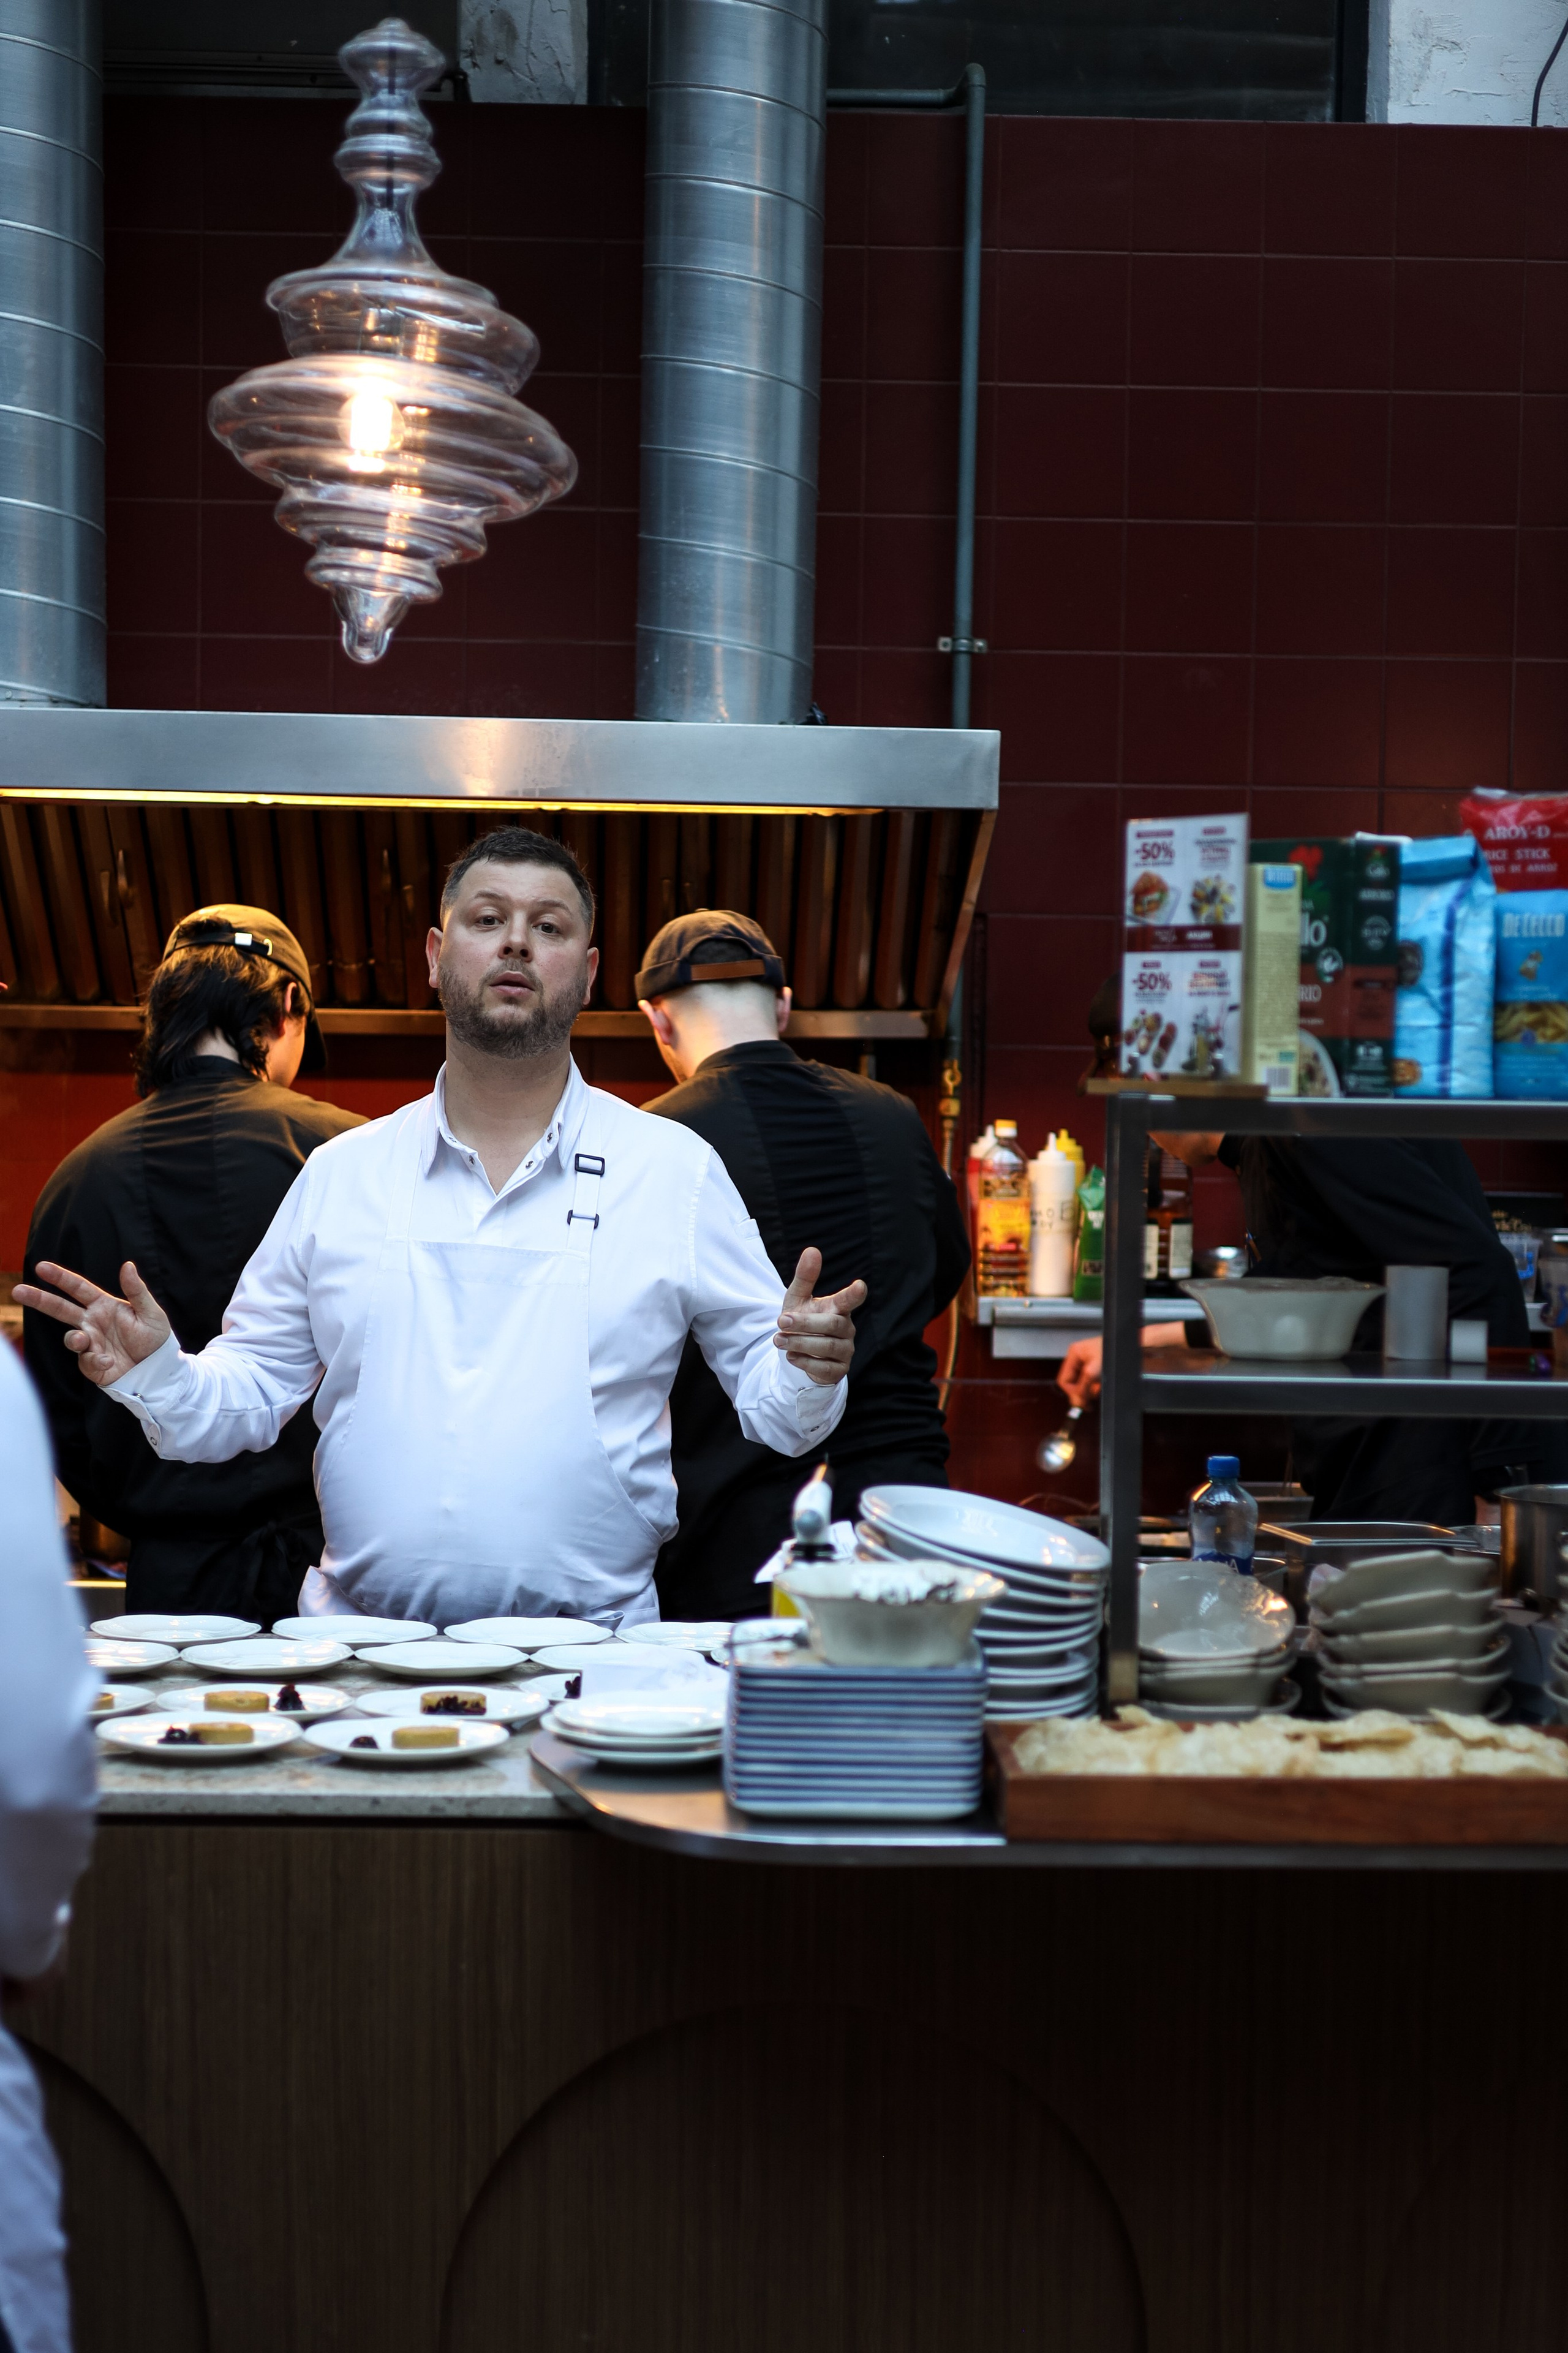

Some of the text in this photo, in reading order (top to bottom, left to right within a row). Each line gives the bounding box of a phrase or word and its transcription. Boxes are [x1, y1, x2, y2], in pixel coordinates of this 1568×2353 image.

[1485, 826, 1551, 840] AROY-D
[1134, 841, 1175, 860] -50%
[1515, 848, 1550, 859] STICK
[1132, 972, 1172, 991] -50%
[1298, 984, 1322, 1003] RIO
